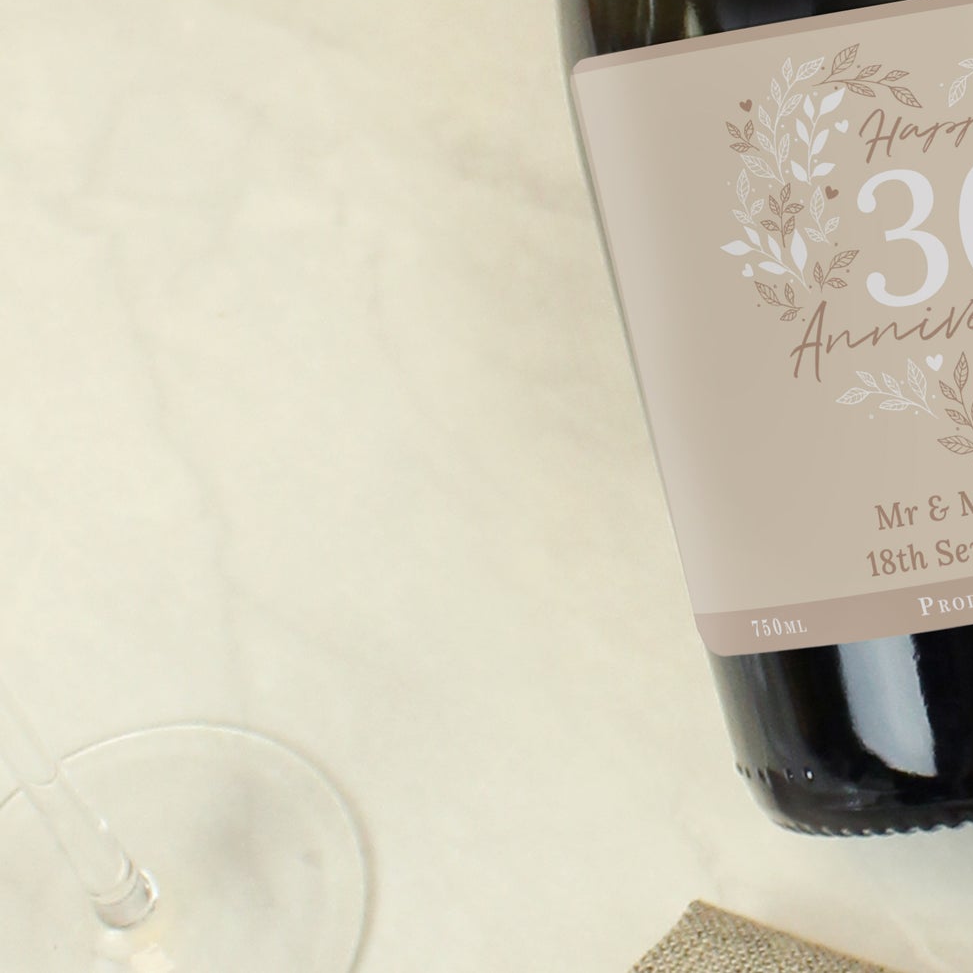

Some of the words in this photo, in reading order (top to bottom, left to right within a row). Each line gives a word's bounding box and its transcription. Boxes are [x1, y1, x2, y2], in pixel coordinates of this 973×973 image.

[874, 501, 919, 531] Mr
[927, 494, 950, 522] &
[865, 543, 929, 577] 18th
